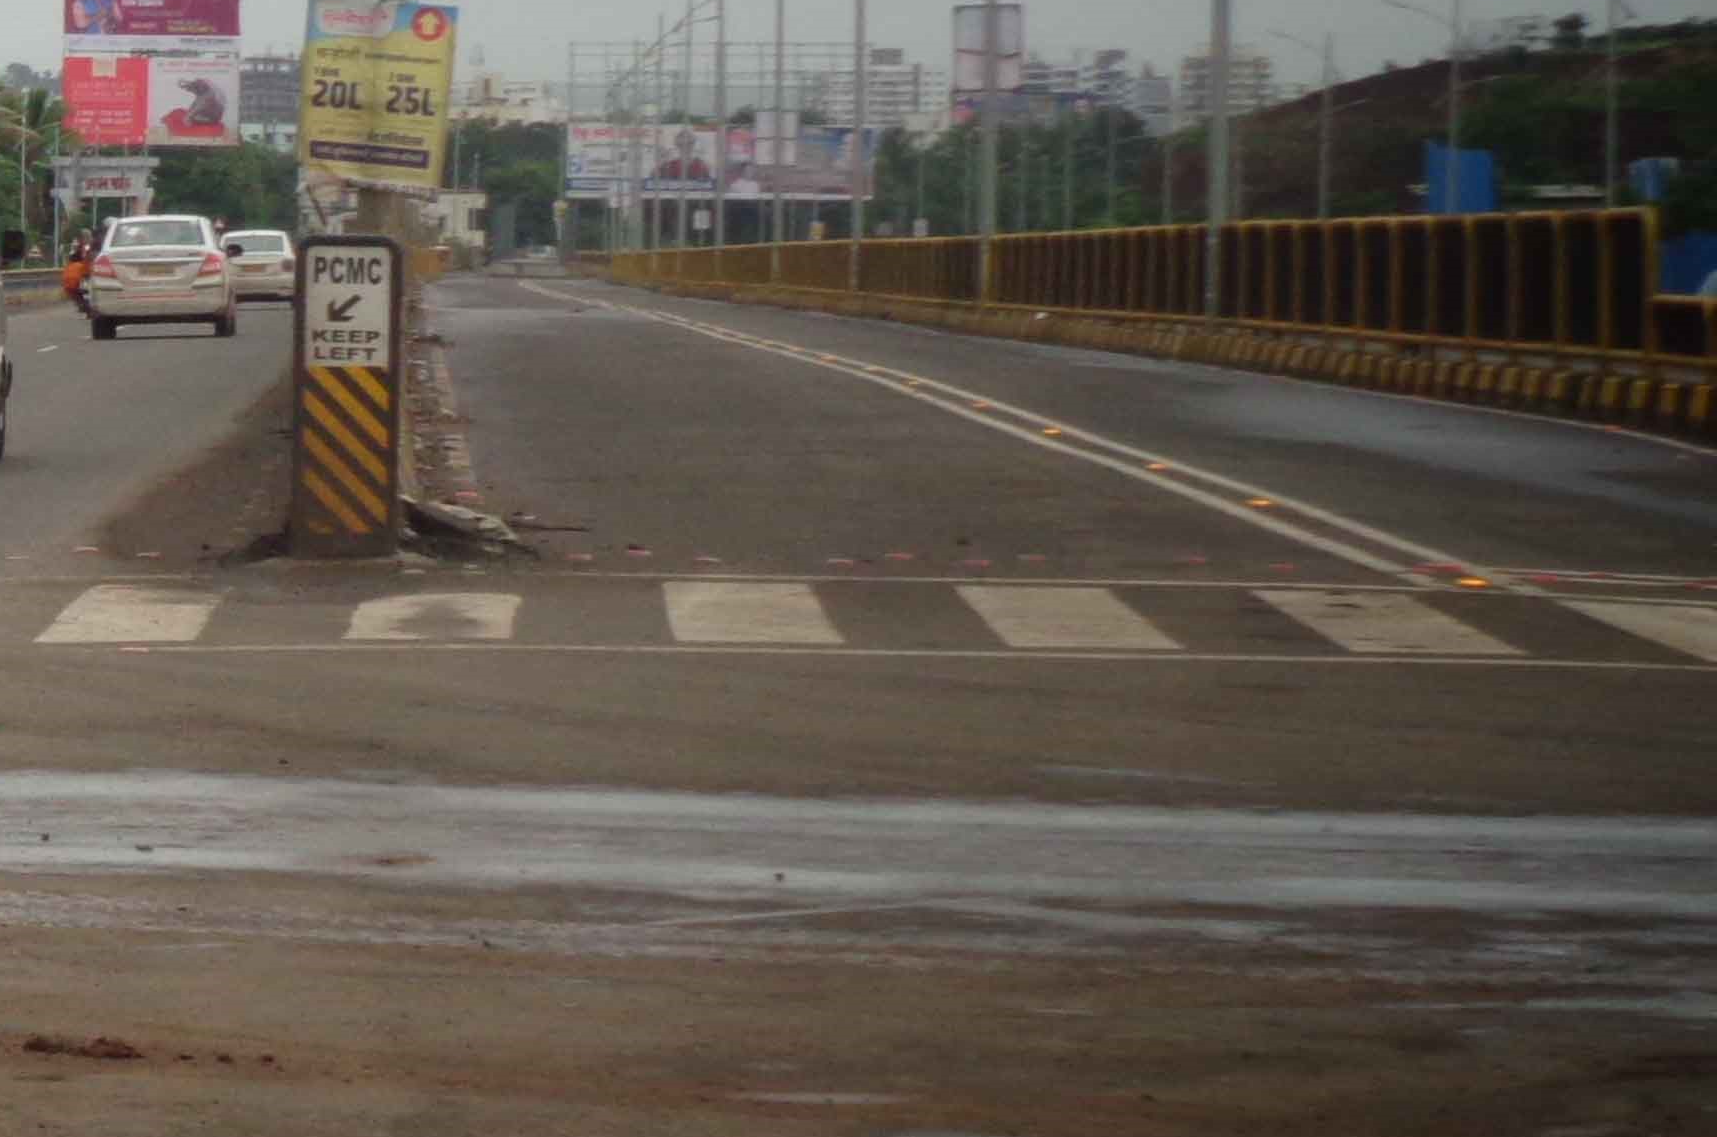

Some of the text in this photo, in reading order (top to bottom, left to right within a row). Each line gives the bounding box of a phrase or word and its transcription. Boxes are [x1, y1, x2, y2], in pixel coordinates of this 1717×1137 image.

[311, 78, 363, 111] 20L
[386, 84, 435, 117] 25L
[312, 255, 382, 285] PCMC
[311, 329, 380, 344] KEEP
[313, 346, 377, 361] LEFT
